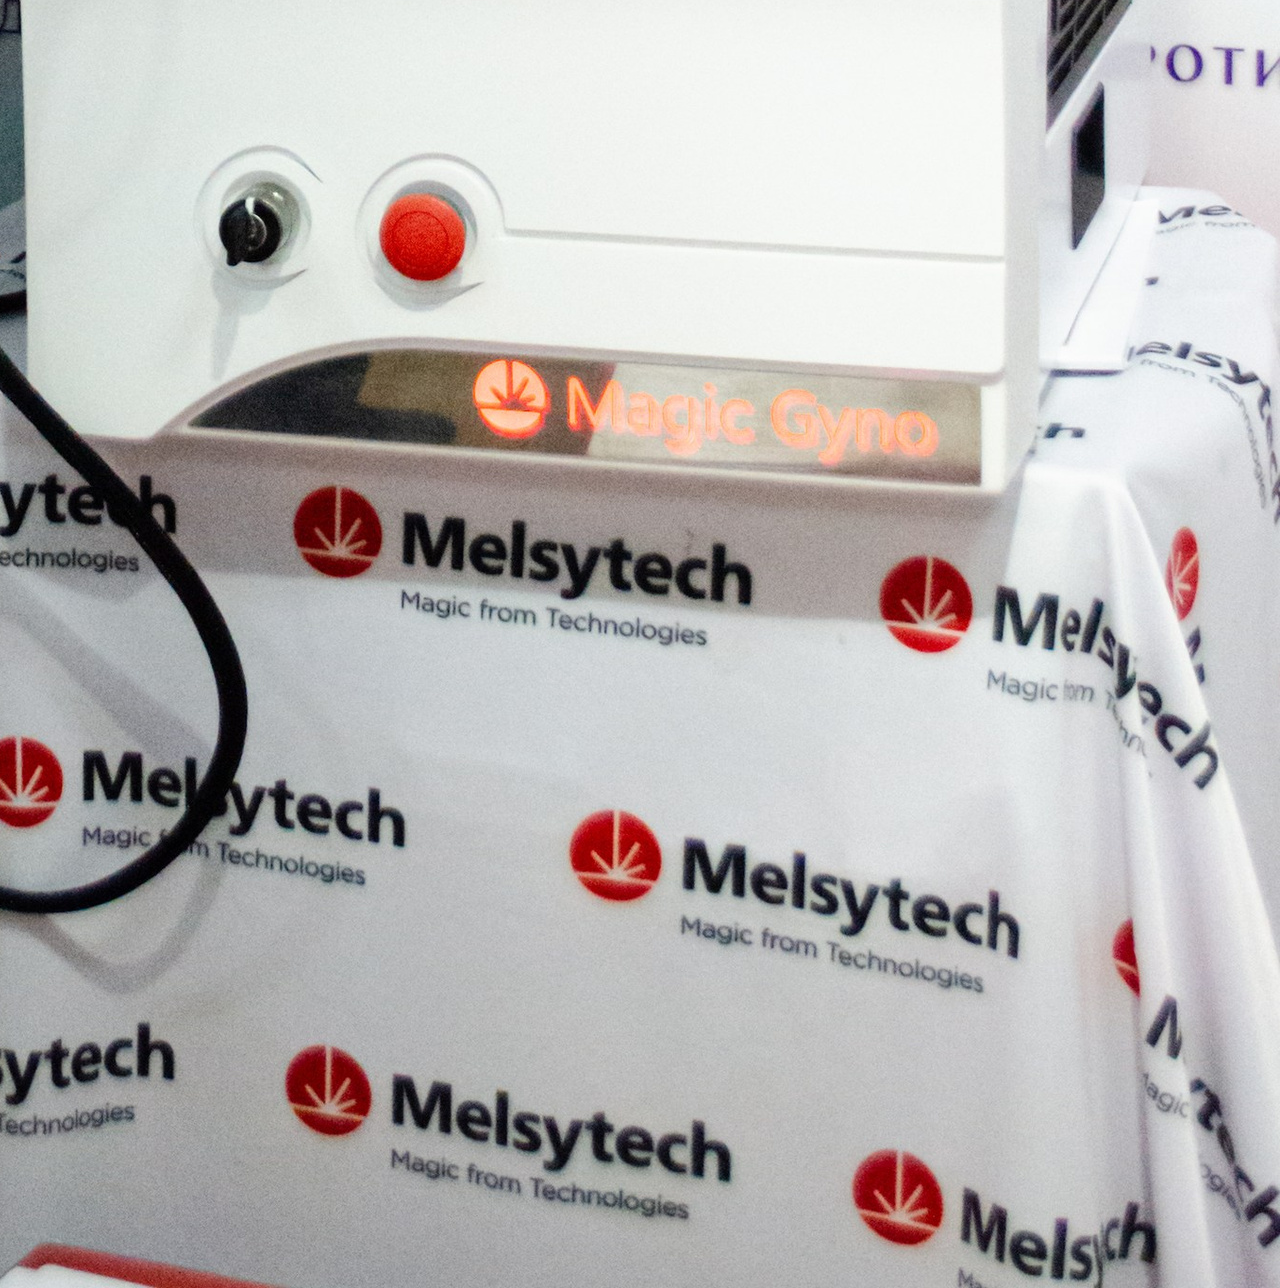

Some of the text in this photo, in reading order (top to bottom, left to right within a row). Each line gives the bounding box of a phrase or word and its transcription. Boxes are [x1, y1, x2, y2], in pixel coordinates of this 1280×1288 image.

[1150, 43, 1280, 87] ОТИ
[566, 374, 940, 467] Magic Gyno
[401, 513, 754, 606] Melsytech
[401, 591, 708, 648] Magic from Technologies
[985, 670, 1059, 702] Magic
[82, 750, 406, 848] Melytech
[82, 826, 151, 850] Magic
[218, 843, 366, 886] Technologies
[682, 838, 1020, 957] Melsytech
[680, 915, 985, 994] Magic from Technologies
[391, 1075, 732, 1181] Melsytech
[390, 1149, 690, 1221] Magic from Technologies
